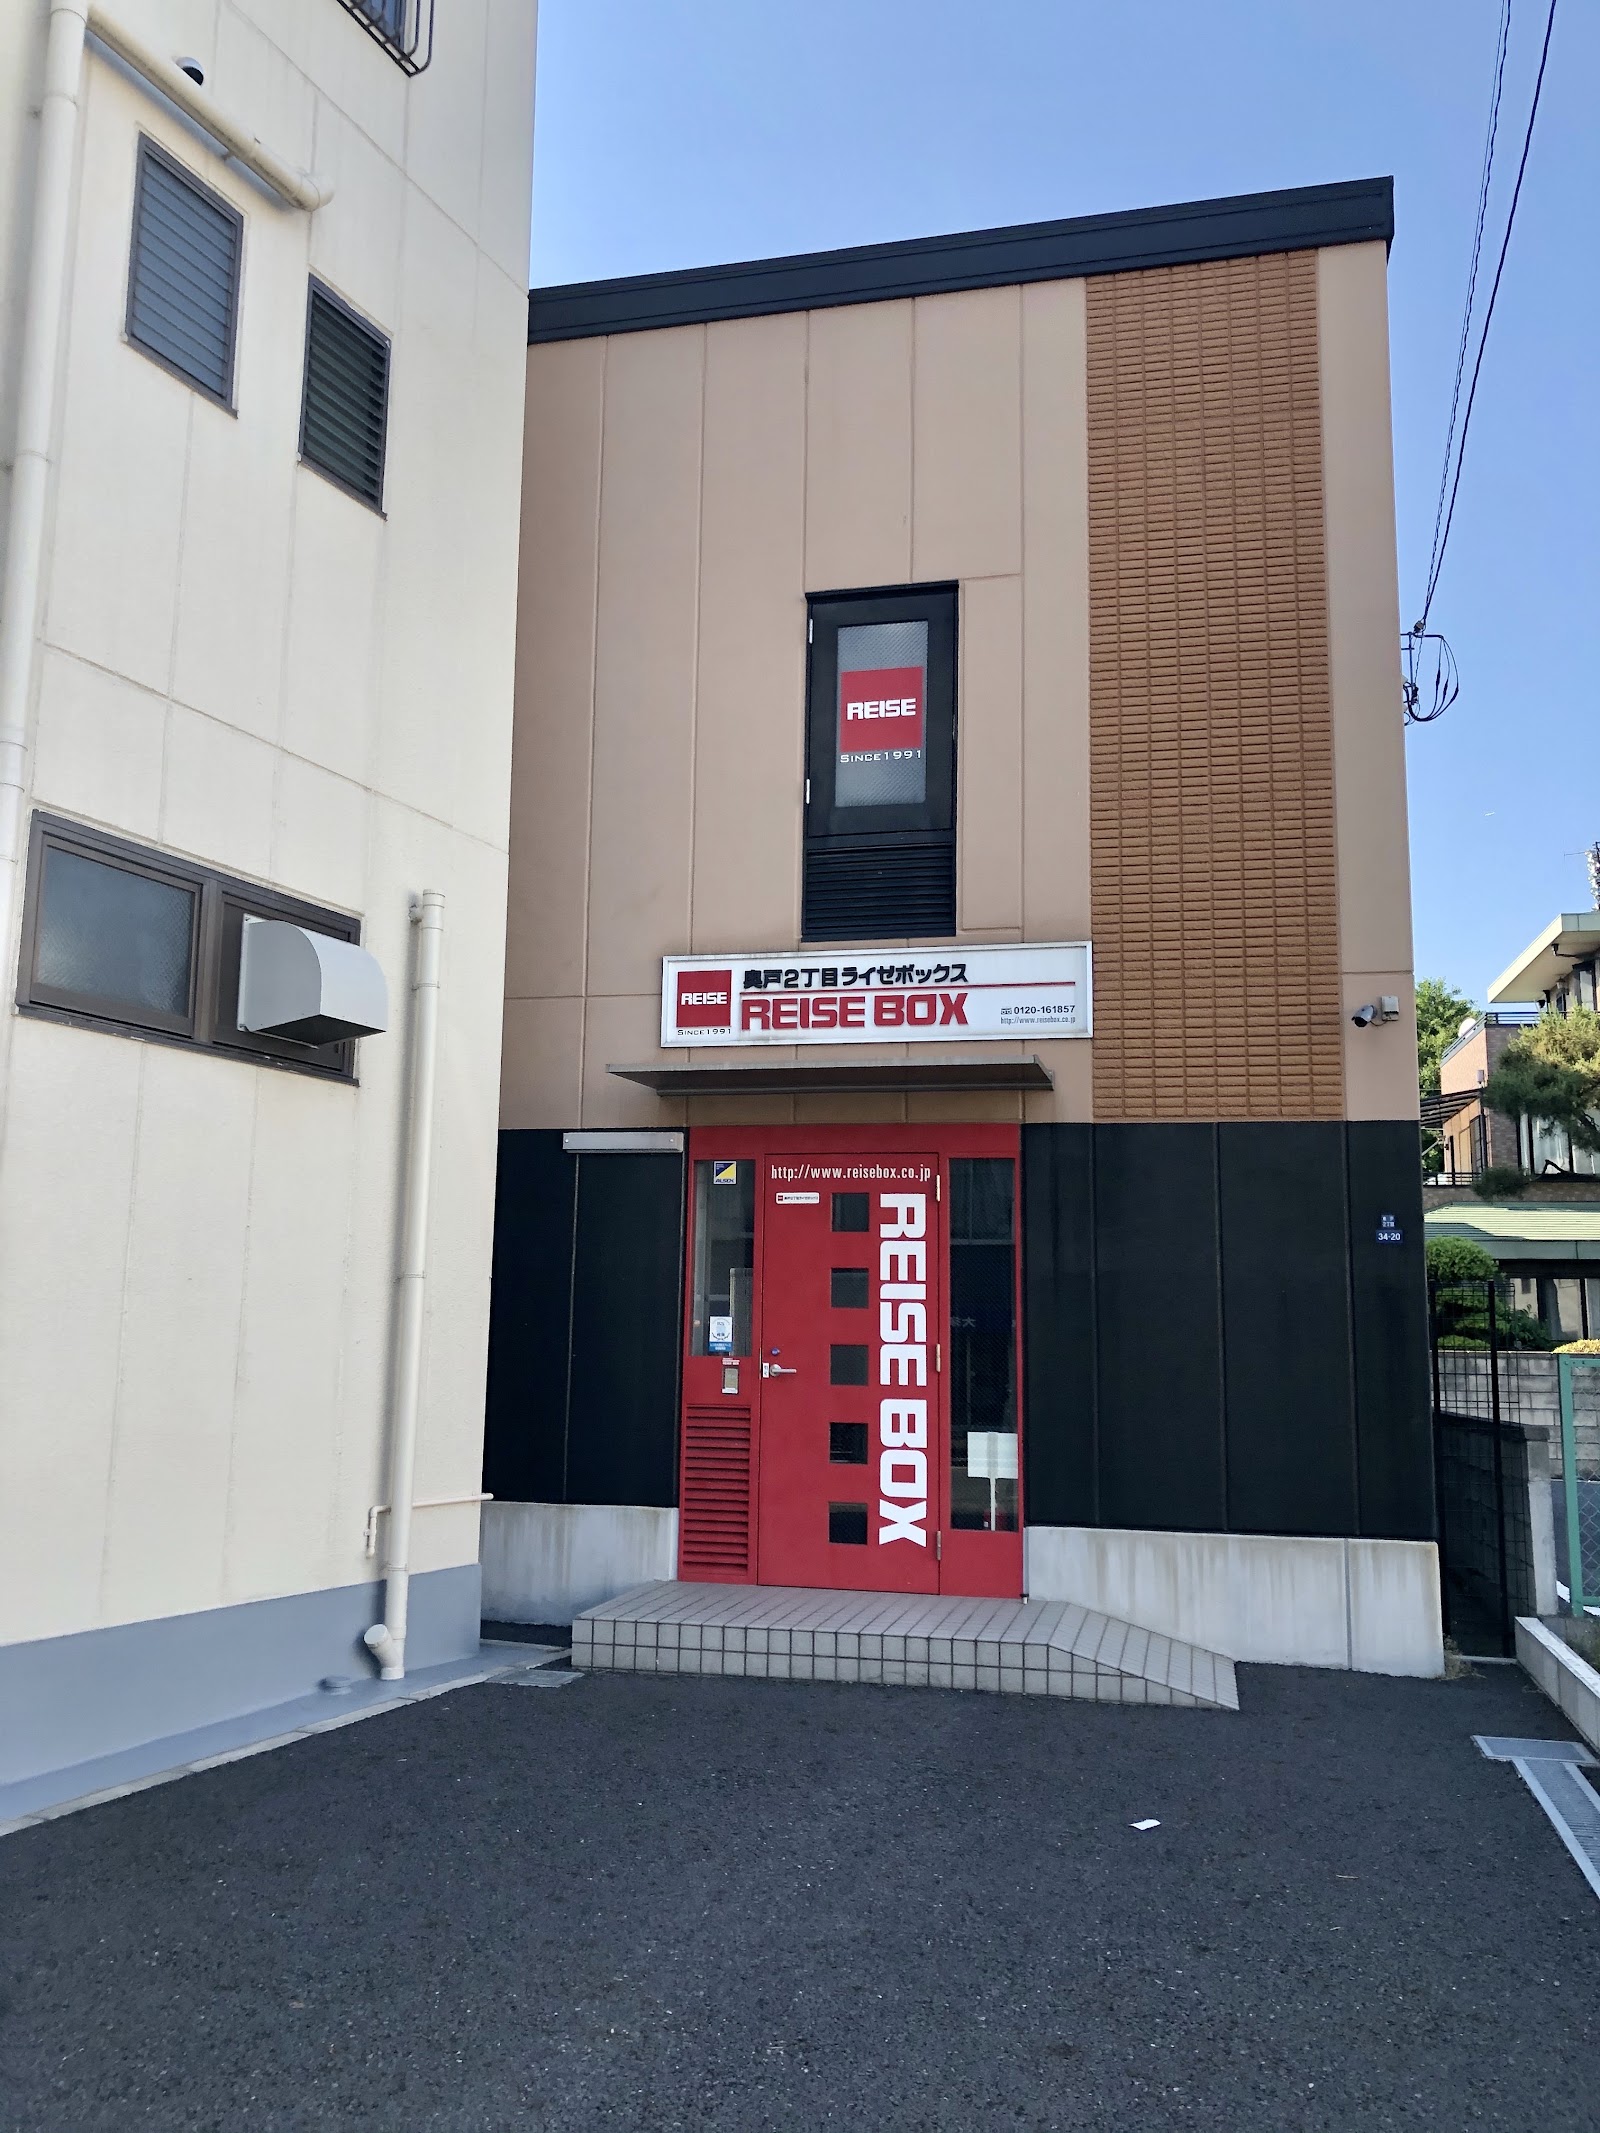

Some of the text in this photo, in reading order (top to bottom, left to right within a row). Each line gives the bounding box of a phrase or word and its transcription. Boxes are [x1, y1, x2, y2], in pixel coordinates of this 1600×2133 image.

[847, 698, 916, 720] REISE
[681, 991, 728, 1006] REISE
[741, 992, 969, 1031] REISE BOX
[1013, 1005, 1076, 1015] 0120-161857
[771, 1164, 931, 1182] http://www.reisebox.co.jp
[1378, 1233, 1401, 1241] 34-20
[879, 1193, 928, 1547] REISE BOX
